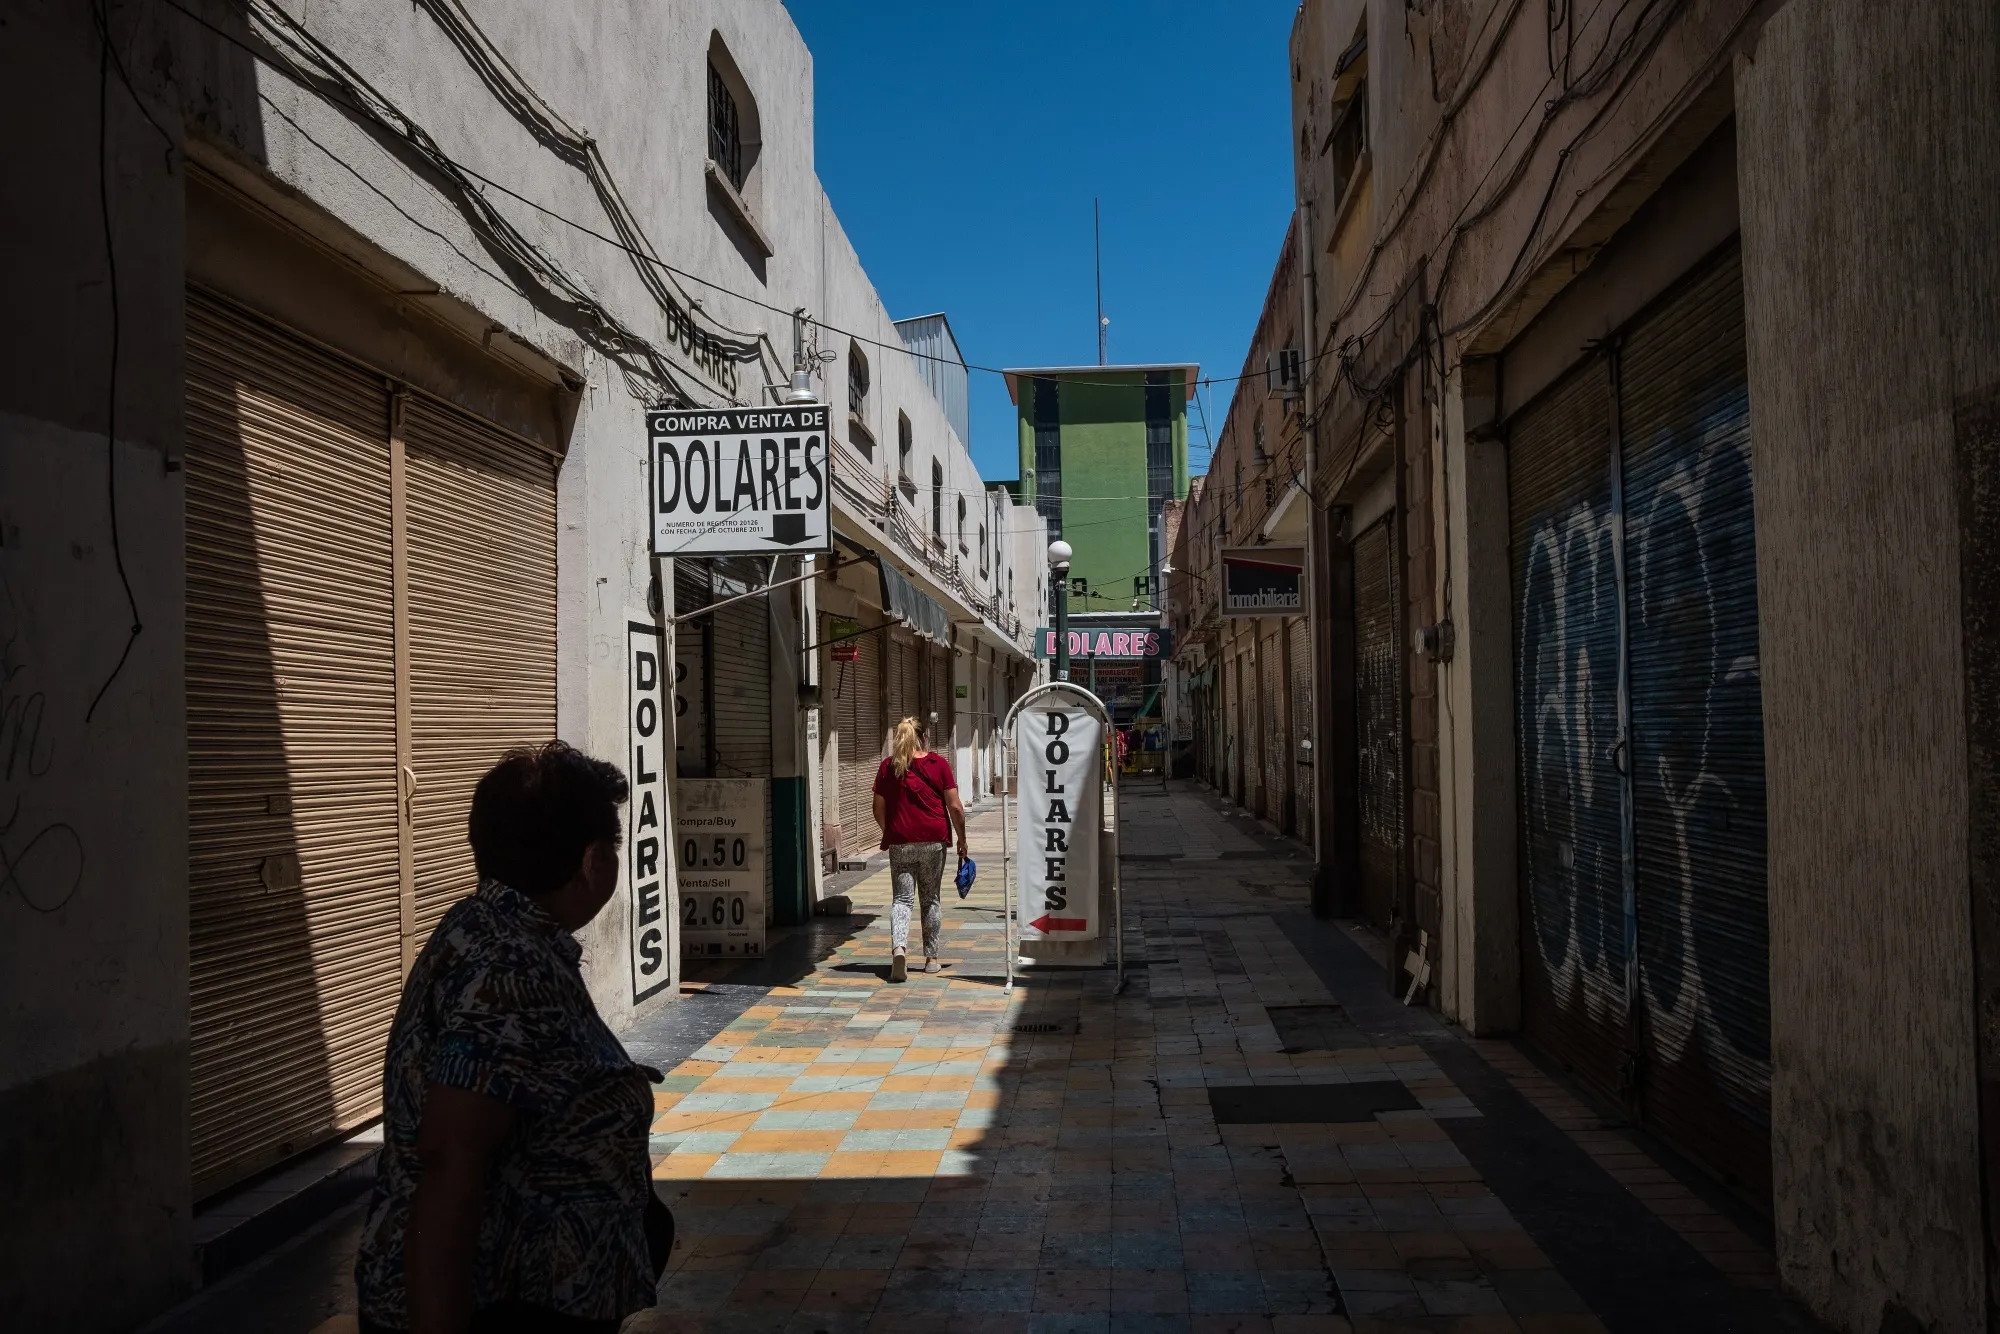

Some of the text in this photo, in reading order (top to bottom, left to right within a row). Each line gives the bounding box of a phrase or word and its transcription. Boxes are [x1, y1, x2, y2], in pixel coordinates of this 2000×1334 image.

[666, 295, 737, 396] DOLARES
[655, 411, 823, 432] COMPRA VENTA DE
[658, 435, 823, 514] DOLARES
[1227, 587, 1300, 609] inmobiliaria
[635, 651, 663, 977] DOLARES
[677, 816, 737, 828] ompra/Buy
[1045, 711, 1072, 911] DOLARES
[679, 878, 730, 888] Venta/Sell
